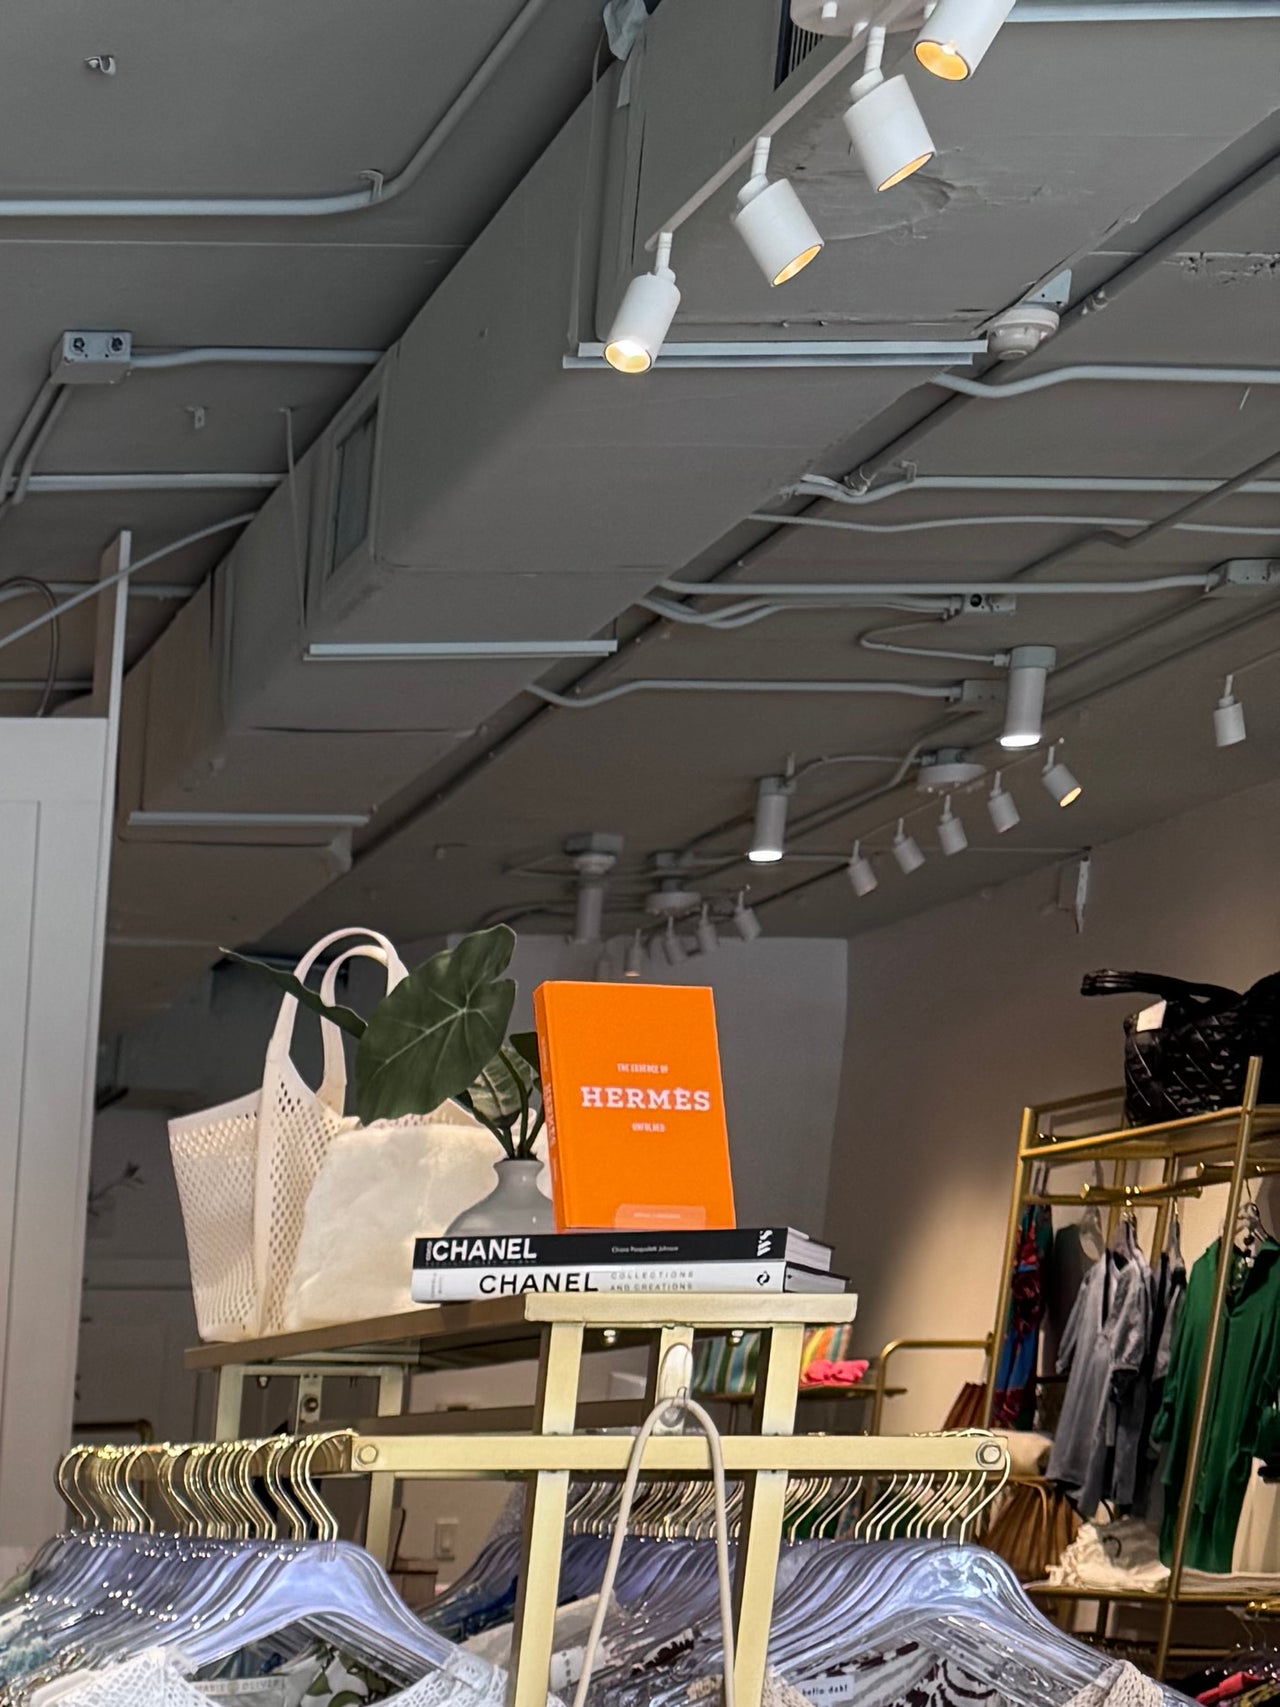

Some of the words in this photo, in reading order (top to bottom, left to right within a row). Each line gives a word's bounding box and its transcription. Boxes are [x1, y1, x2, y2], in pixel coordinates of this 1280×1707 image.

[432, 1238, 537, 1262] CHANEL
[611, 1271, 693, 1280] COLLECTIONS
[479, 1273, 598, 1294] CHANEL
[610, 1284, 630, 1292] AND
[634, 1283, 693, 1292] CREATIONS
